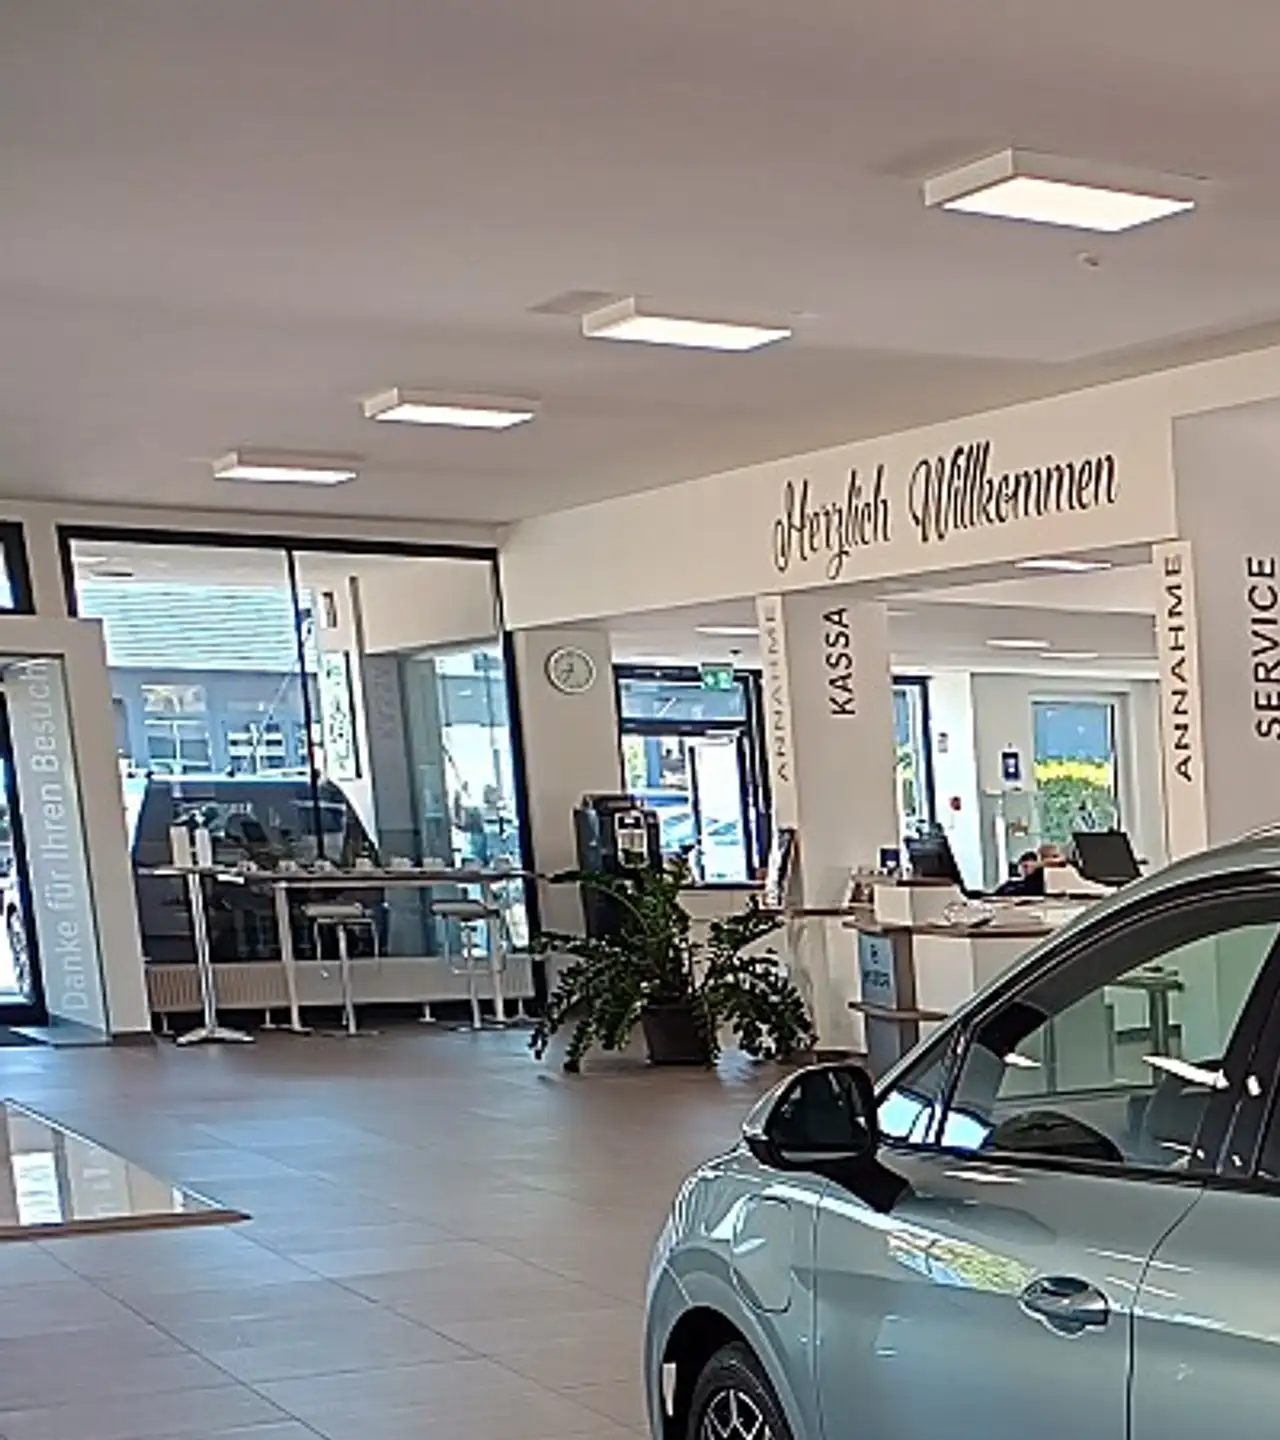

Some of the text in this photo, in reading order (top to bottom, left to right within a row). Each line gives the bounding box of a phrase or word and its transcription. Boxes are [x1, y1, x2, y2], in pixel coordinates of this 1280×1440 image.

[773, 440, 1117, 580] Herzlich Willkommen
[822, 607, 857, 716] KASSA
[1164, 554, 1193, 783] ANNAHME
[19, 662, 89, 1011] Danke für Ihren Besuch
